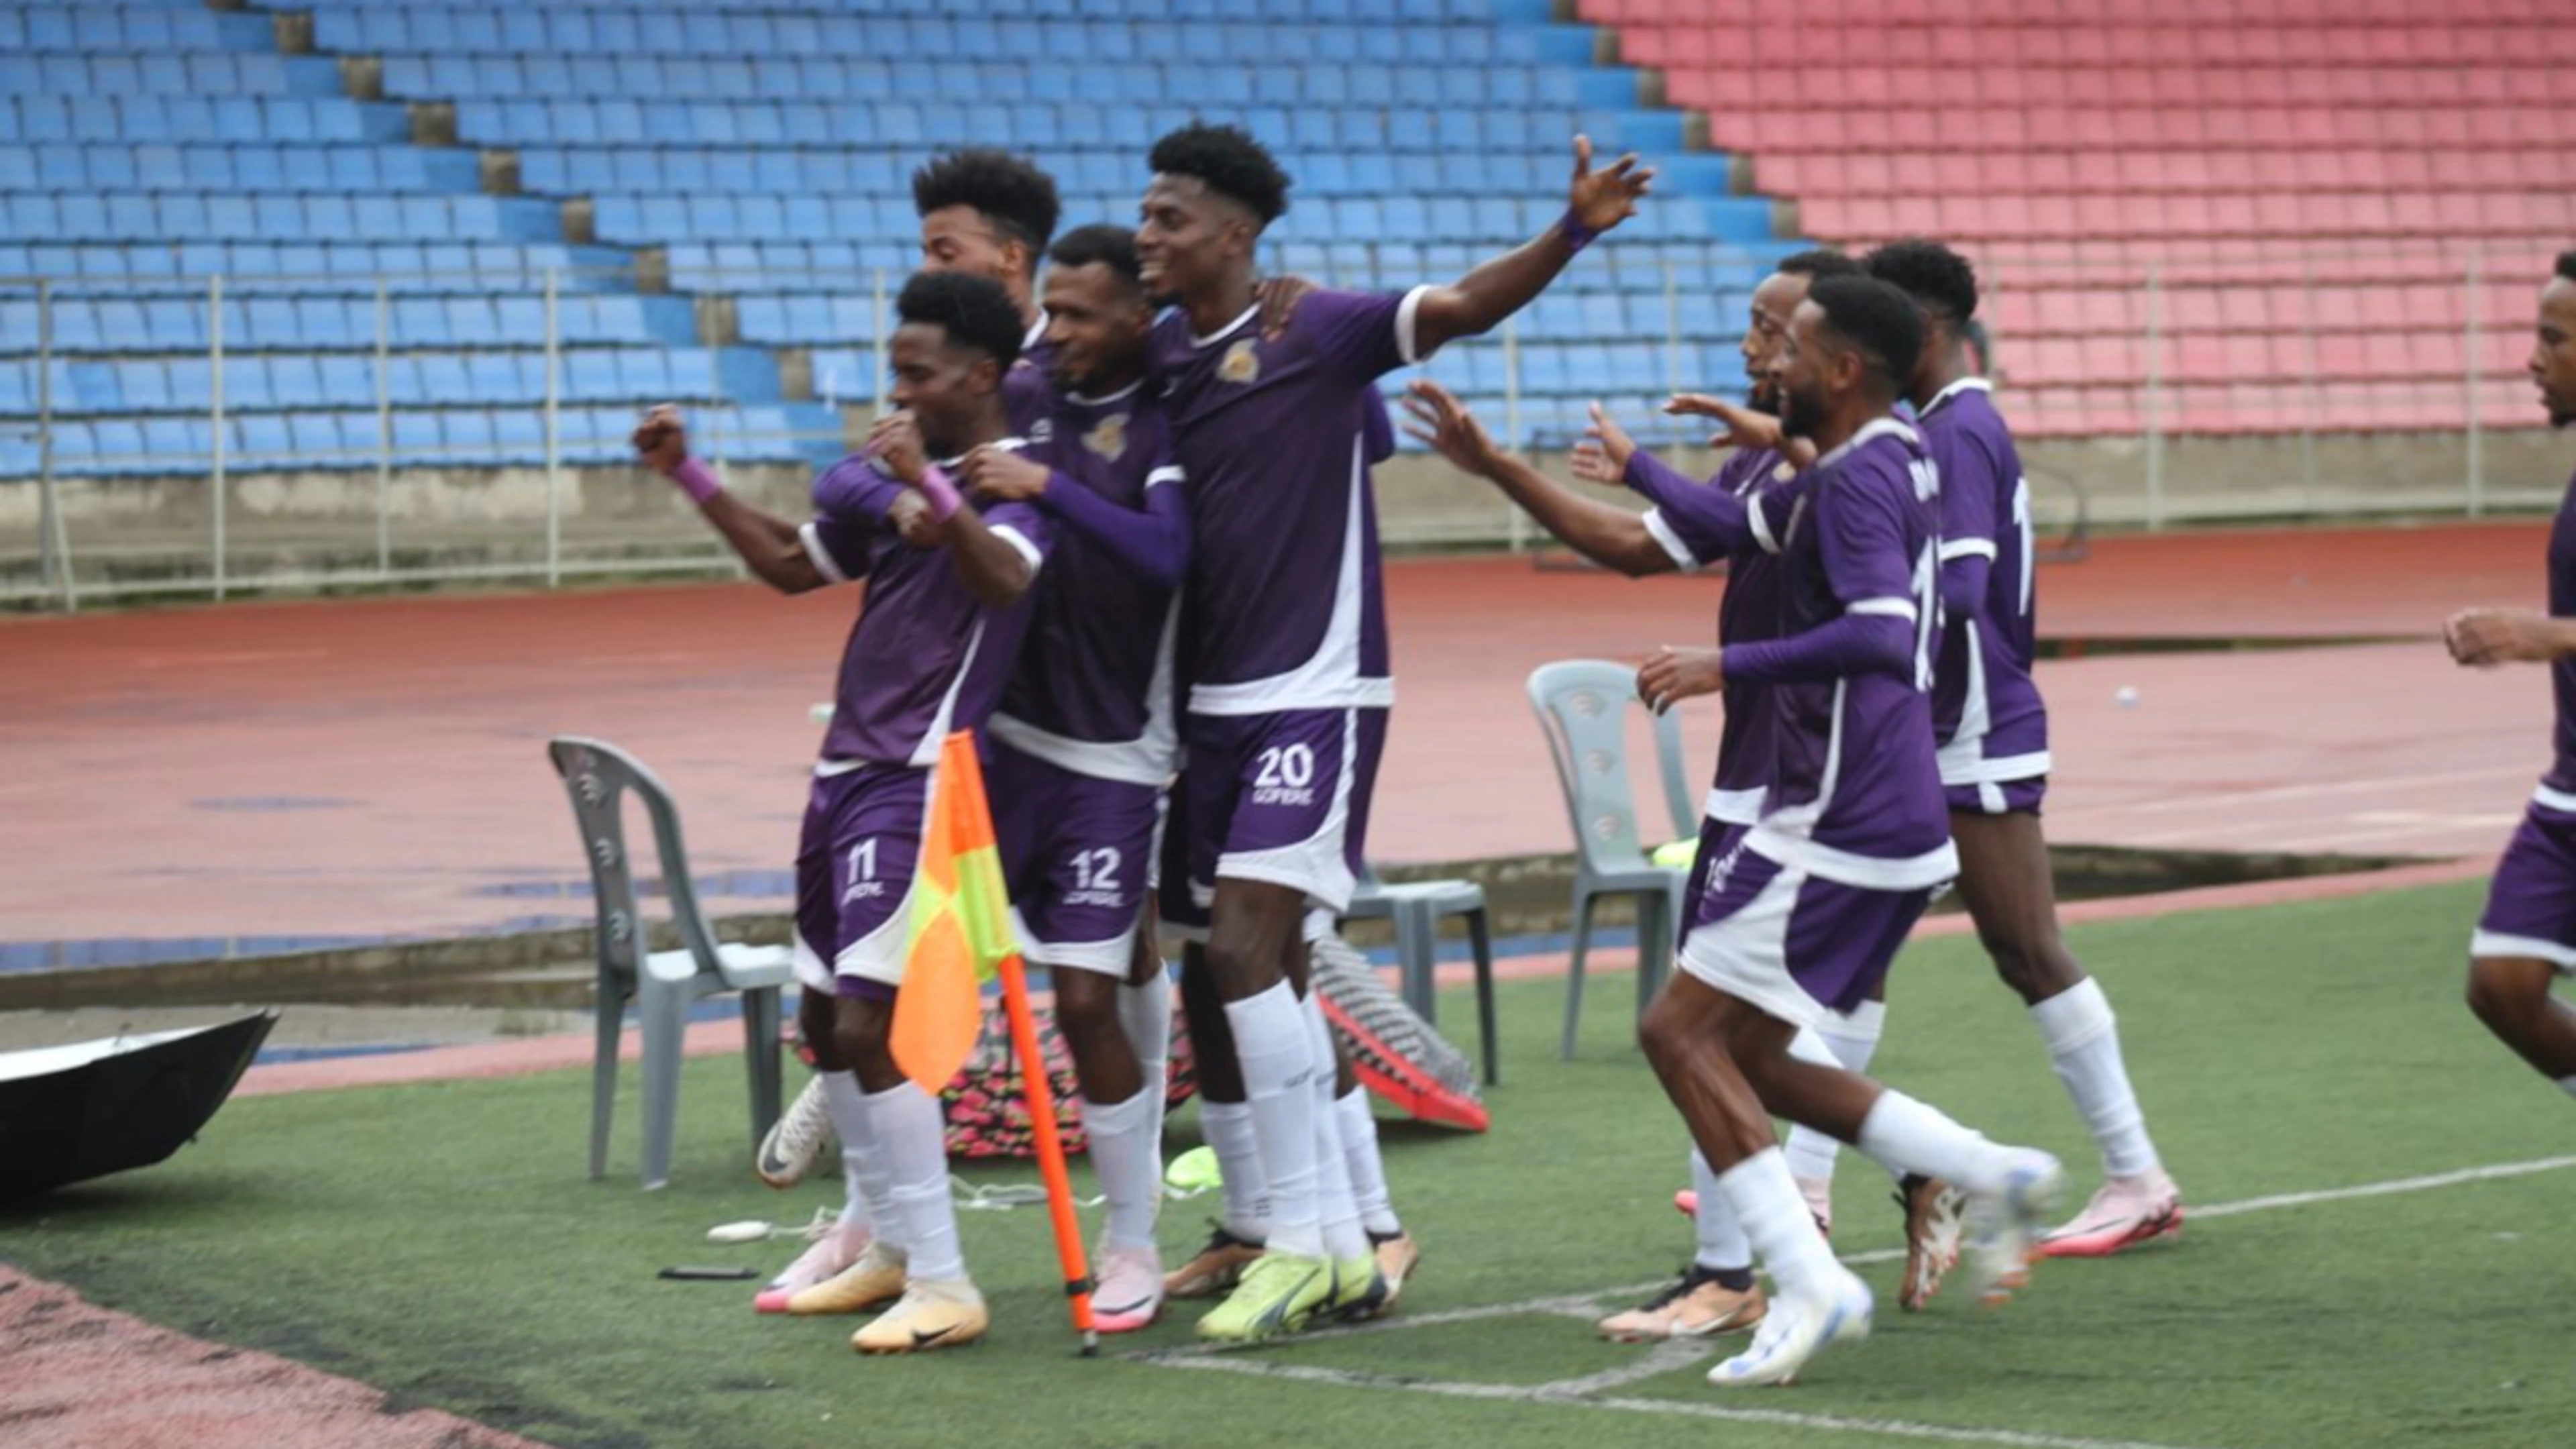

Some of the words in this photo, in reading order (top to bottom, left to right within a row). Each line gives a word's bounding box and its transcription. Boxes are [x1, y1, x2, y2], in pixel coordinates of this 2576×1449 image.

[1254, 742, 1313, 788] 20
[847, 837, 877, 885] 11
[1068, 847, 1121, 890] 12
